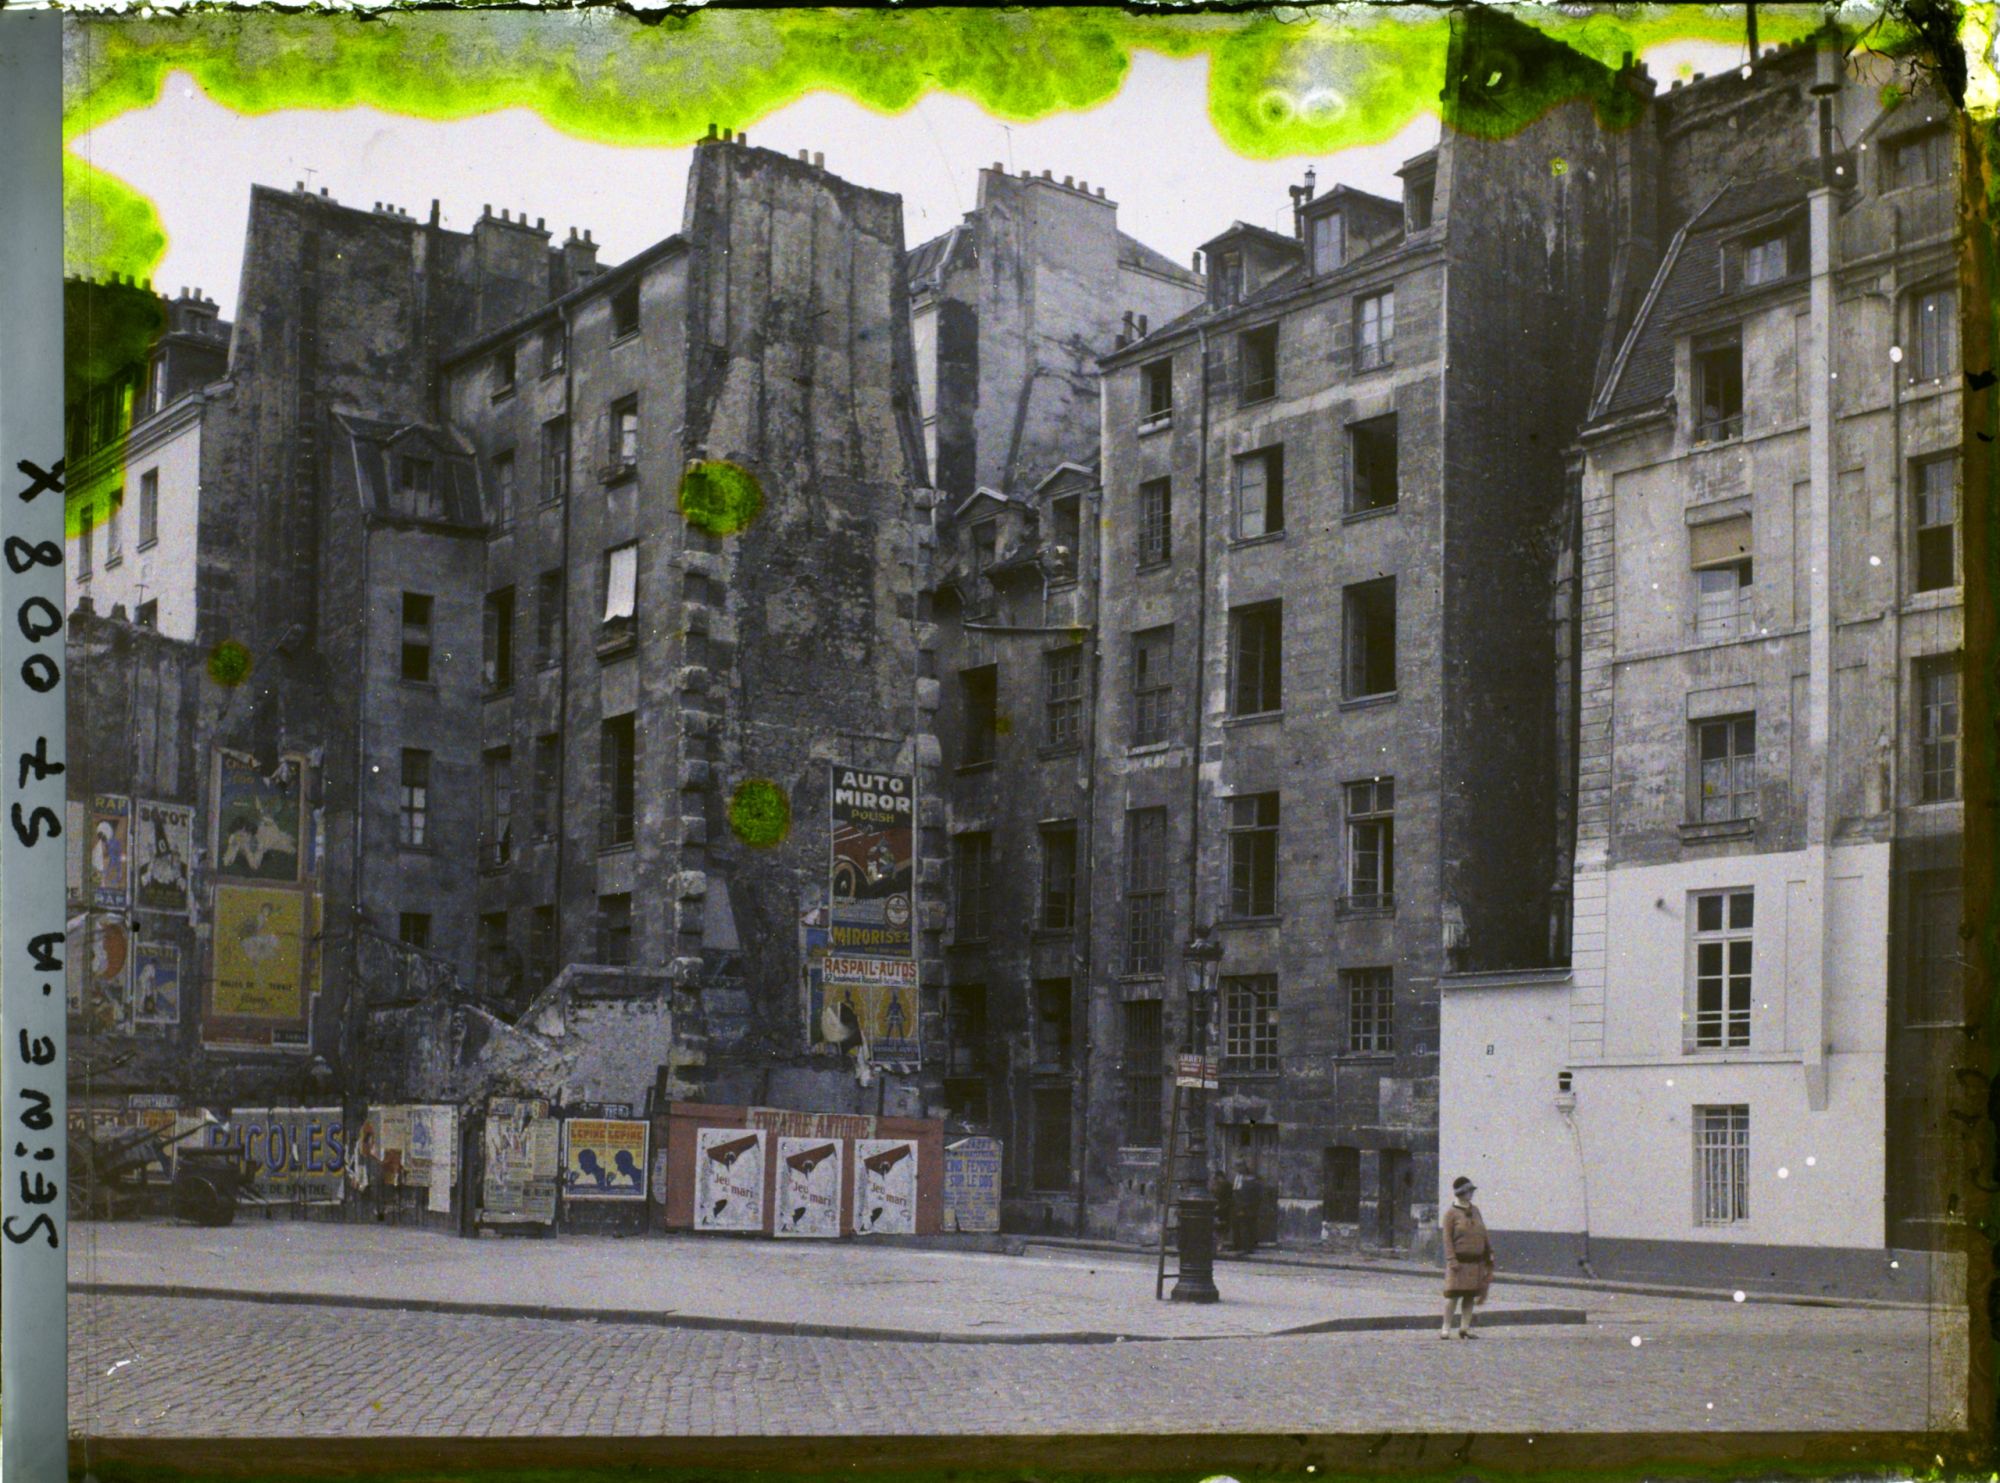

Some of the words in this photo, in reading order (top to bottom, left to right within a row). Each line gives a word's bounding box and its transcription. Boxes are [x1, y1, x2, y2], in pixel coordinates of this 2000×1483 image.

[840, 770, 905, 793] AUTO
[835, 788, 911, 814] MIROR
[851, 809, 895, 823] POLISH
[824, 958, 917, 978] RASPAIL-AUTOS
